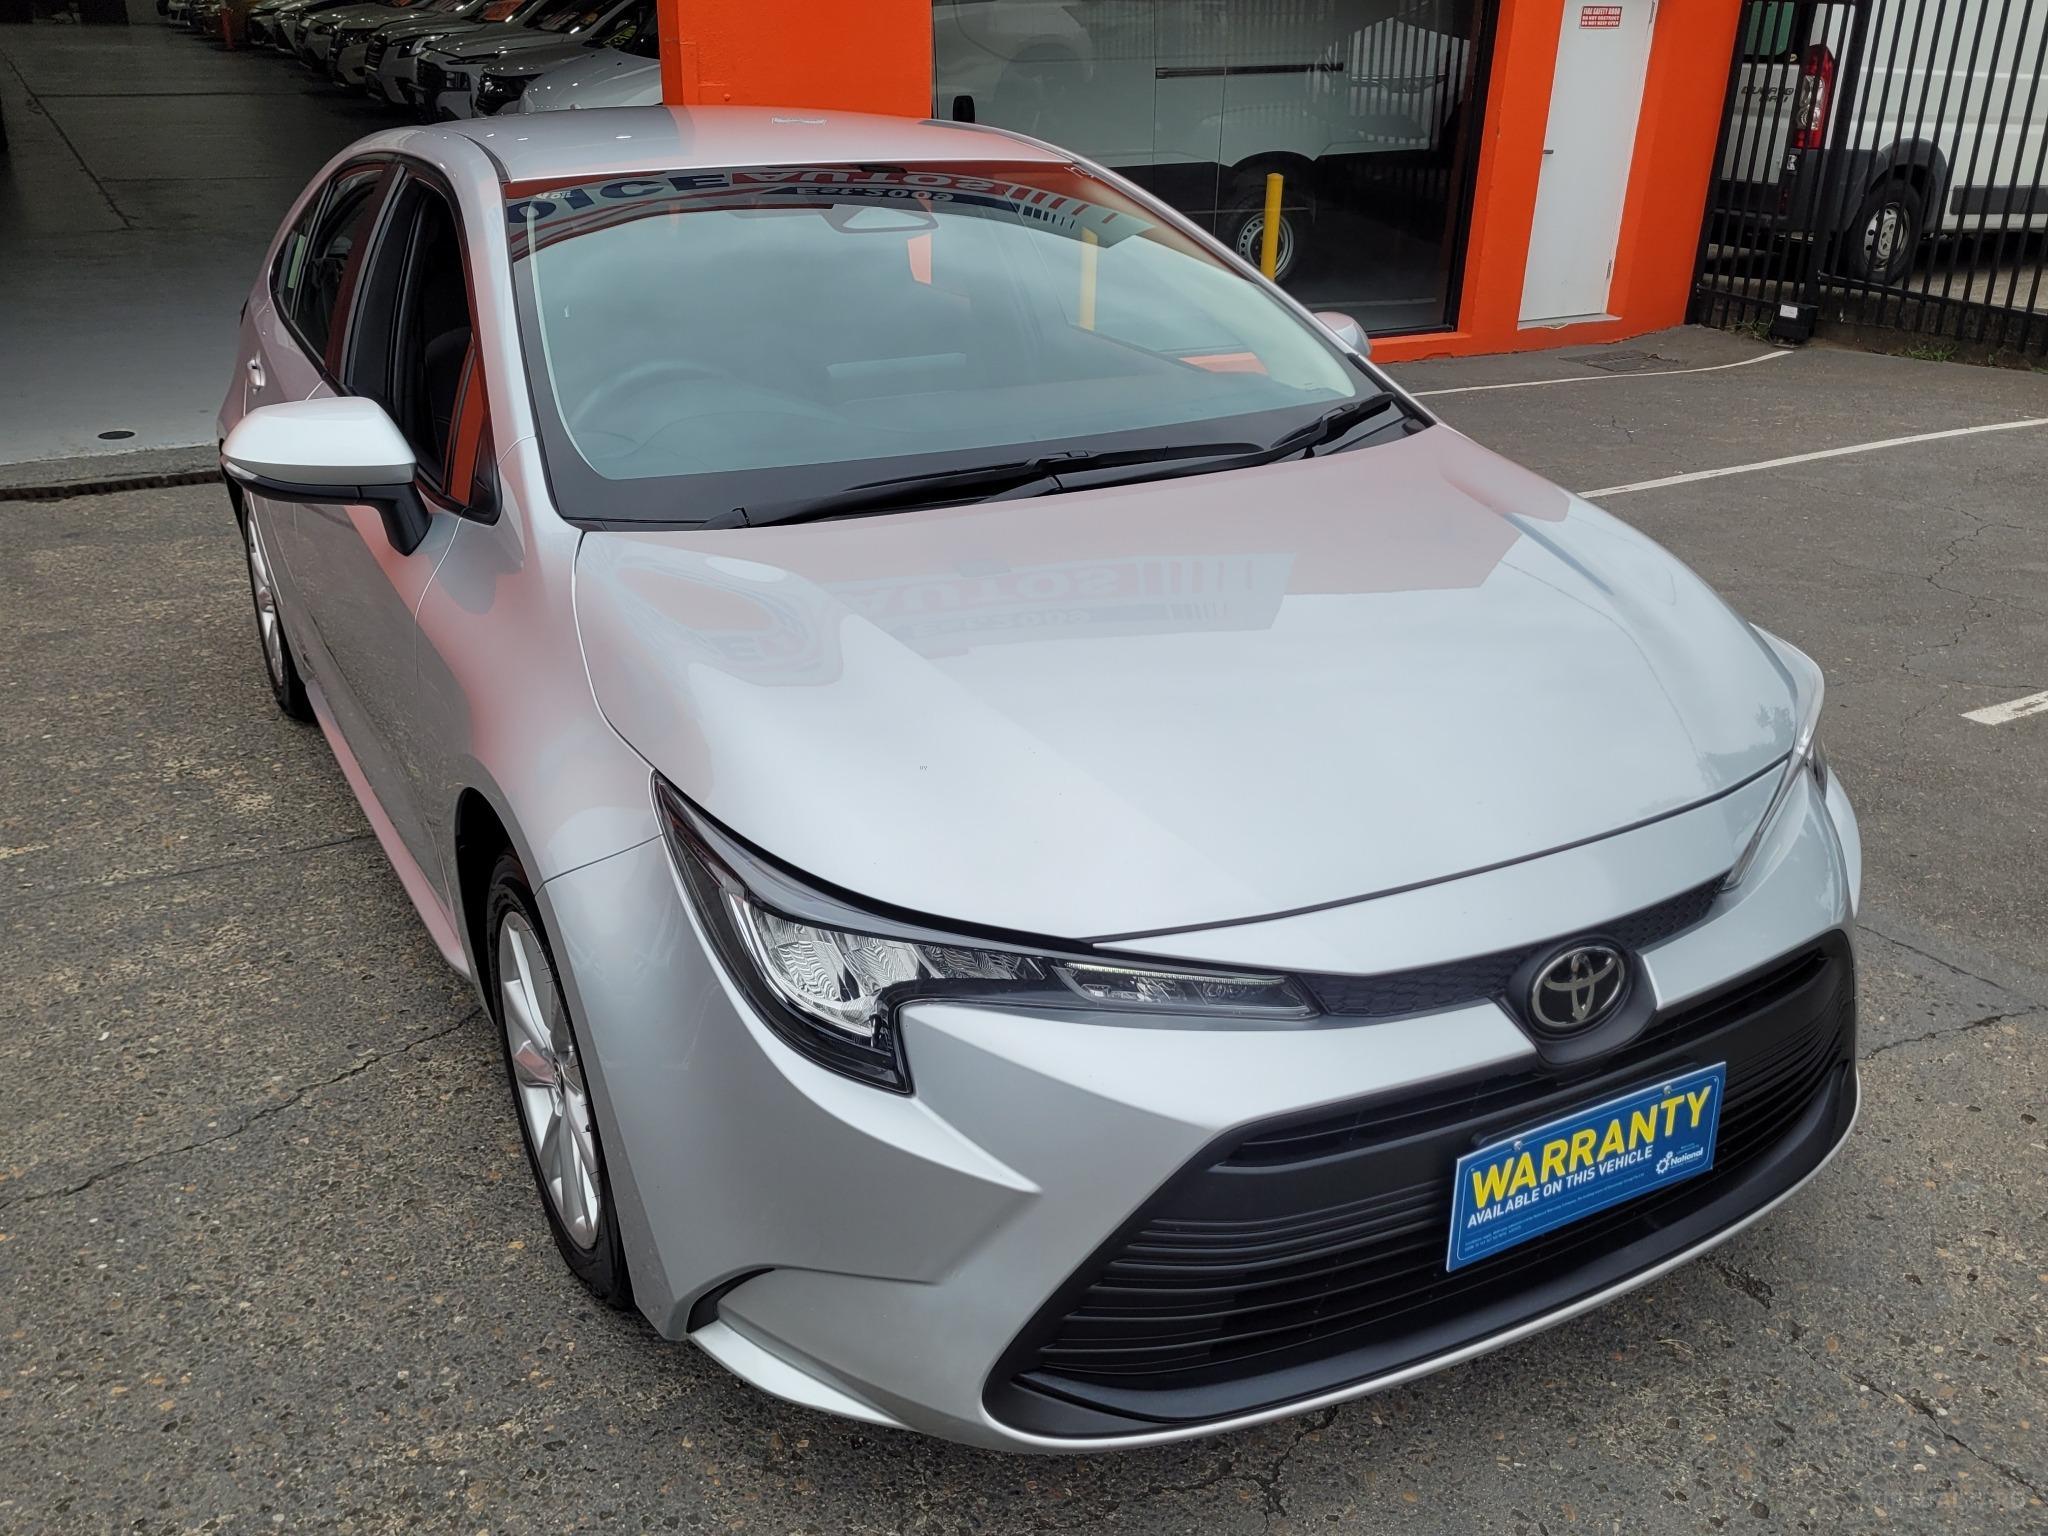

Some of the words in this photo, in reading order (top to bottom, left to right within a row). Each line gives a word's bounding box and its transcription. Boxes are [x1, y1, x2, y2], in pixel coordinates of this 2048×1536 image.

[1467, 1187, 1540, 1228] AVAILABLE
[1543, 1179, 1562, 1197] ON
[1566, 1164, 1595, 1189] THIS
[1599, 1145, 1653, 1176] VEHICLE
[1472, 1085, 1712, 1209] WARRANTY
[1670, 1146, 1704, 1167] National
